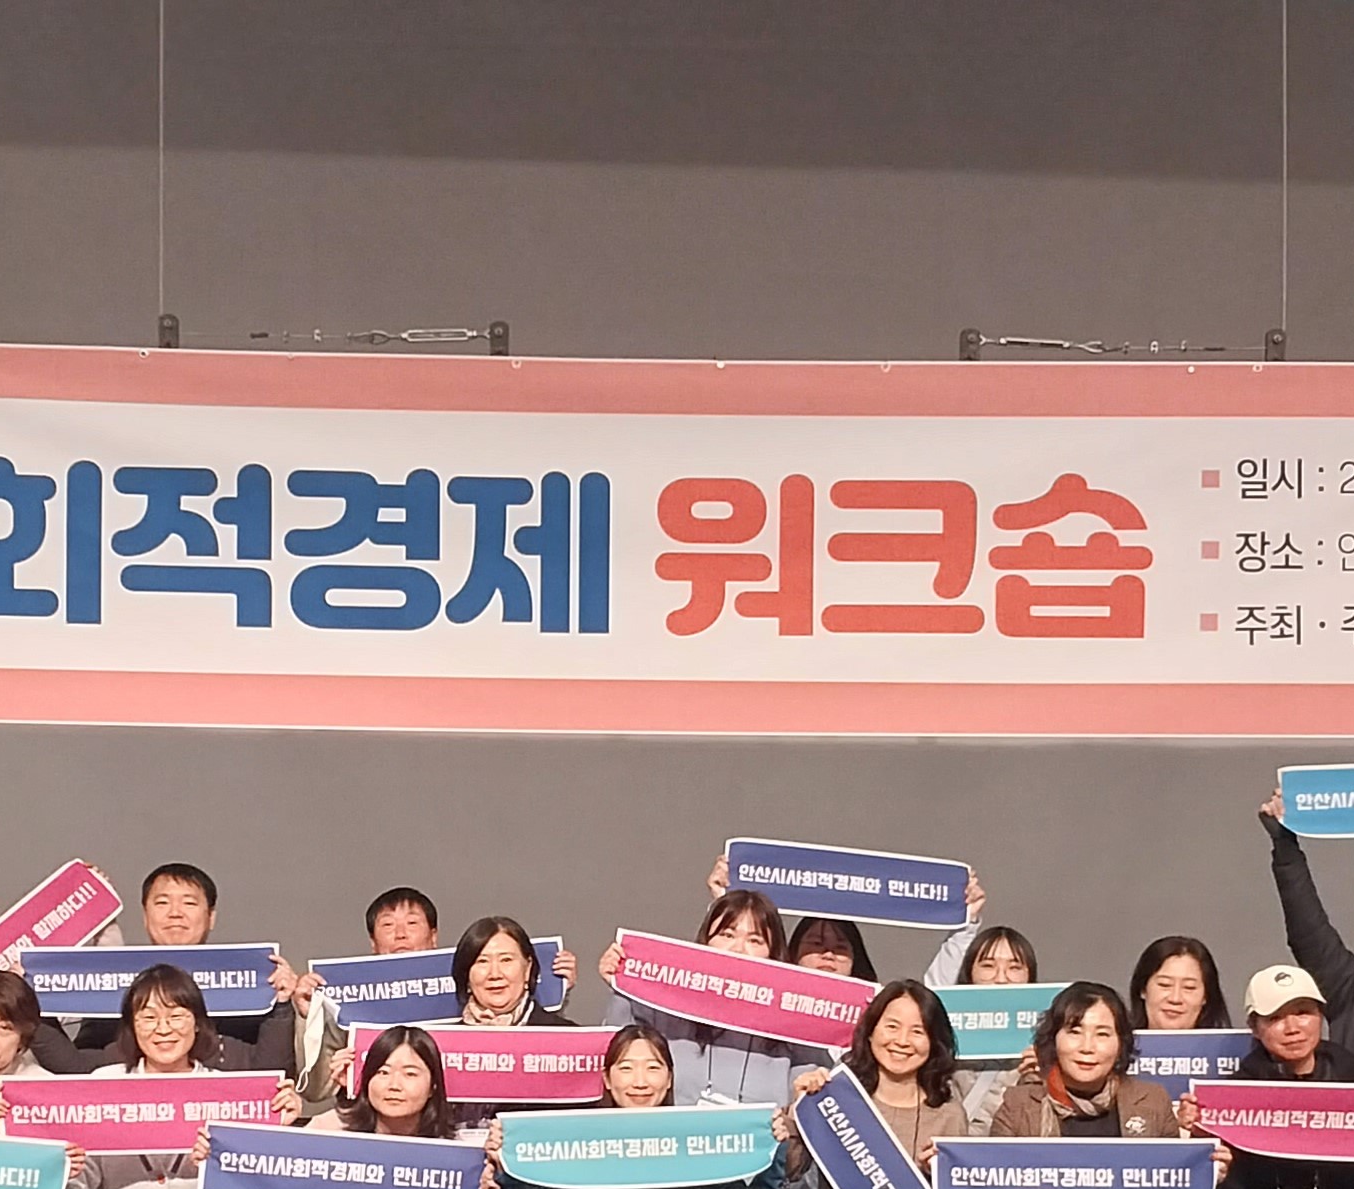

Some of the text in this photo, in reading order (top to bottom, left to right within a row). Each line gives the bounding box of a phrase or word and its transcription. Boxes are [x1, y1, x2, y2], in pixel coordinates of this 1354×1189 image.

[1238, 459, 1304, 501] 일시
[654, 473, 1157, 642] 워크숍
[1236, 532, 1305, 574] 장소
[1236, 606, 1303, 647] 주최
[739, 864, 950, 903] 안산시사회적경제와 만나다!!
[30, 880, 99, 943] 함께하다!!
[34, 971, 258, 993] 안산시사회적 만나다!!
[322, 977, 458, 1010] 안산시사회적경제
[623, 956, 863, 1029] 안산시사회적경제와 함께하다!!
[523, 1054, 606, 1074] 함께하다!!
[11, 1100, 271, 1125] 안산시사회적경제와 함께하다!!
[516, 1134, 756, 1164] 안산시사회적경제와 만나다!!
[220, 1152, 386, 1185] 안산시사회적경제와
[951, 1167, 1192, 1189] 안산시사회적경제와 만나다!!
